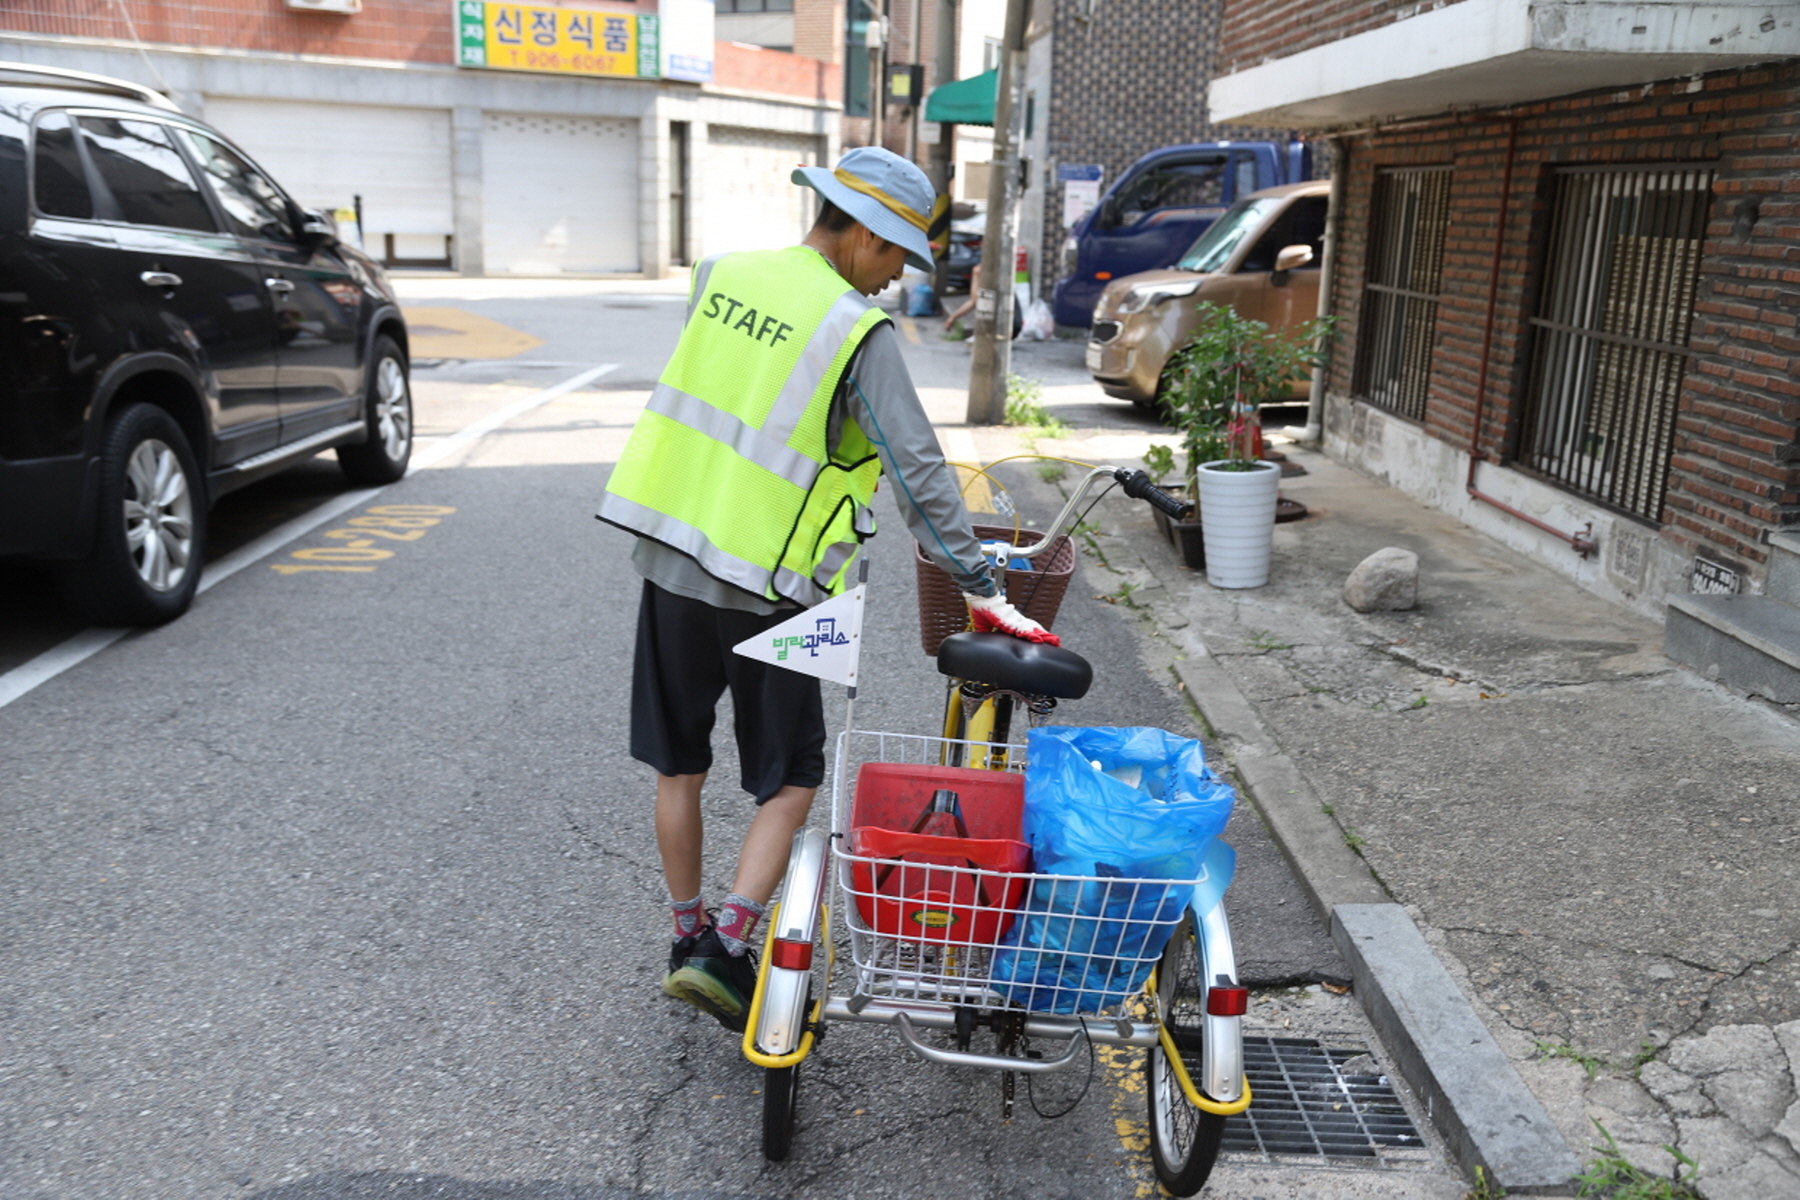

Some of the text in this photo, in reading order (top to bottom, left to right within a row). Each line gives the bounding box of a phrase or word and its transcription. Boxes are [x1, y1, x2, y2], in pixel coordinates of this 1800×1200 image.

[494, 8, 630, 52] 신정식품
[526, 51, 616, 72] 906-6067
[703, 292, 794, 347] STAFF
[270, 504, 458, 575] 10-280
